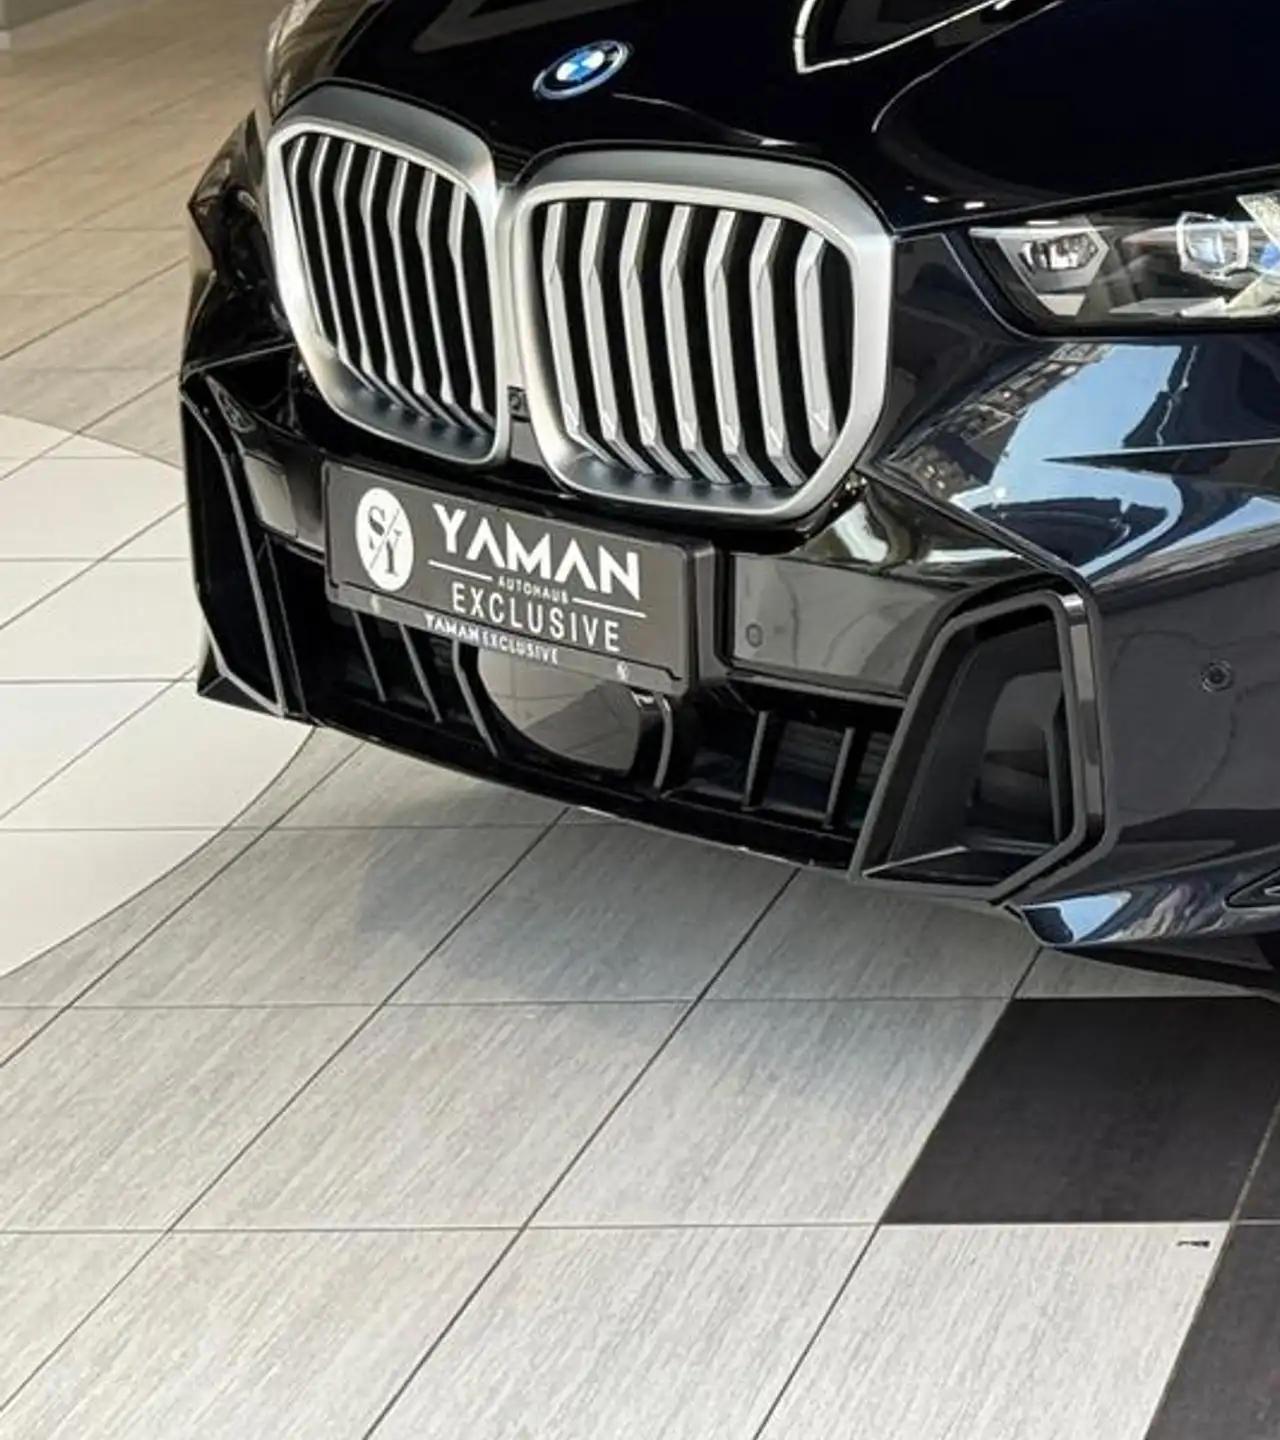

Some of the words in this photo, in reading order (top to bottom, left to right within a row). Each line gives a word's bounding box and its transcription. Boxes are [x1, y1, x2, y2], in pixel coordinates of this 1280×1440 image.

[432, 503, 641, 601] YAMAN
[452, 582, 621, 652] EXCLUSIVE
[498, 575, 568, 605] AUTOHAUS
[424, 611, 479, 641] YAMAN
[482, 631, 559, 665] EXCLUSIVE
